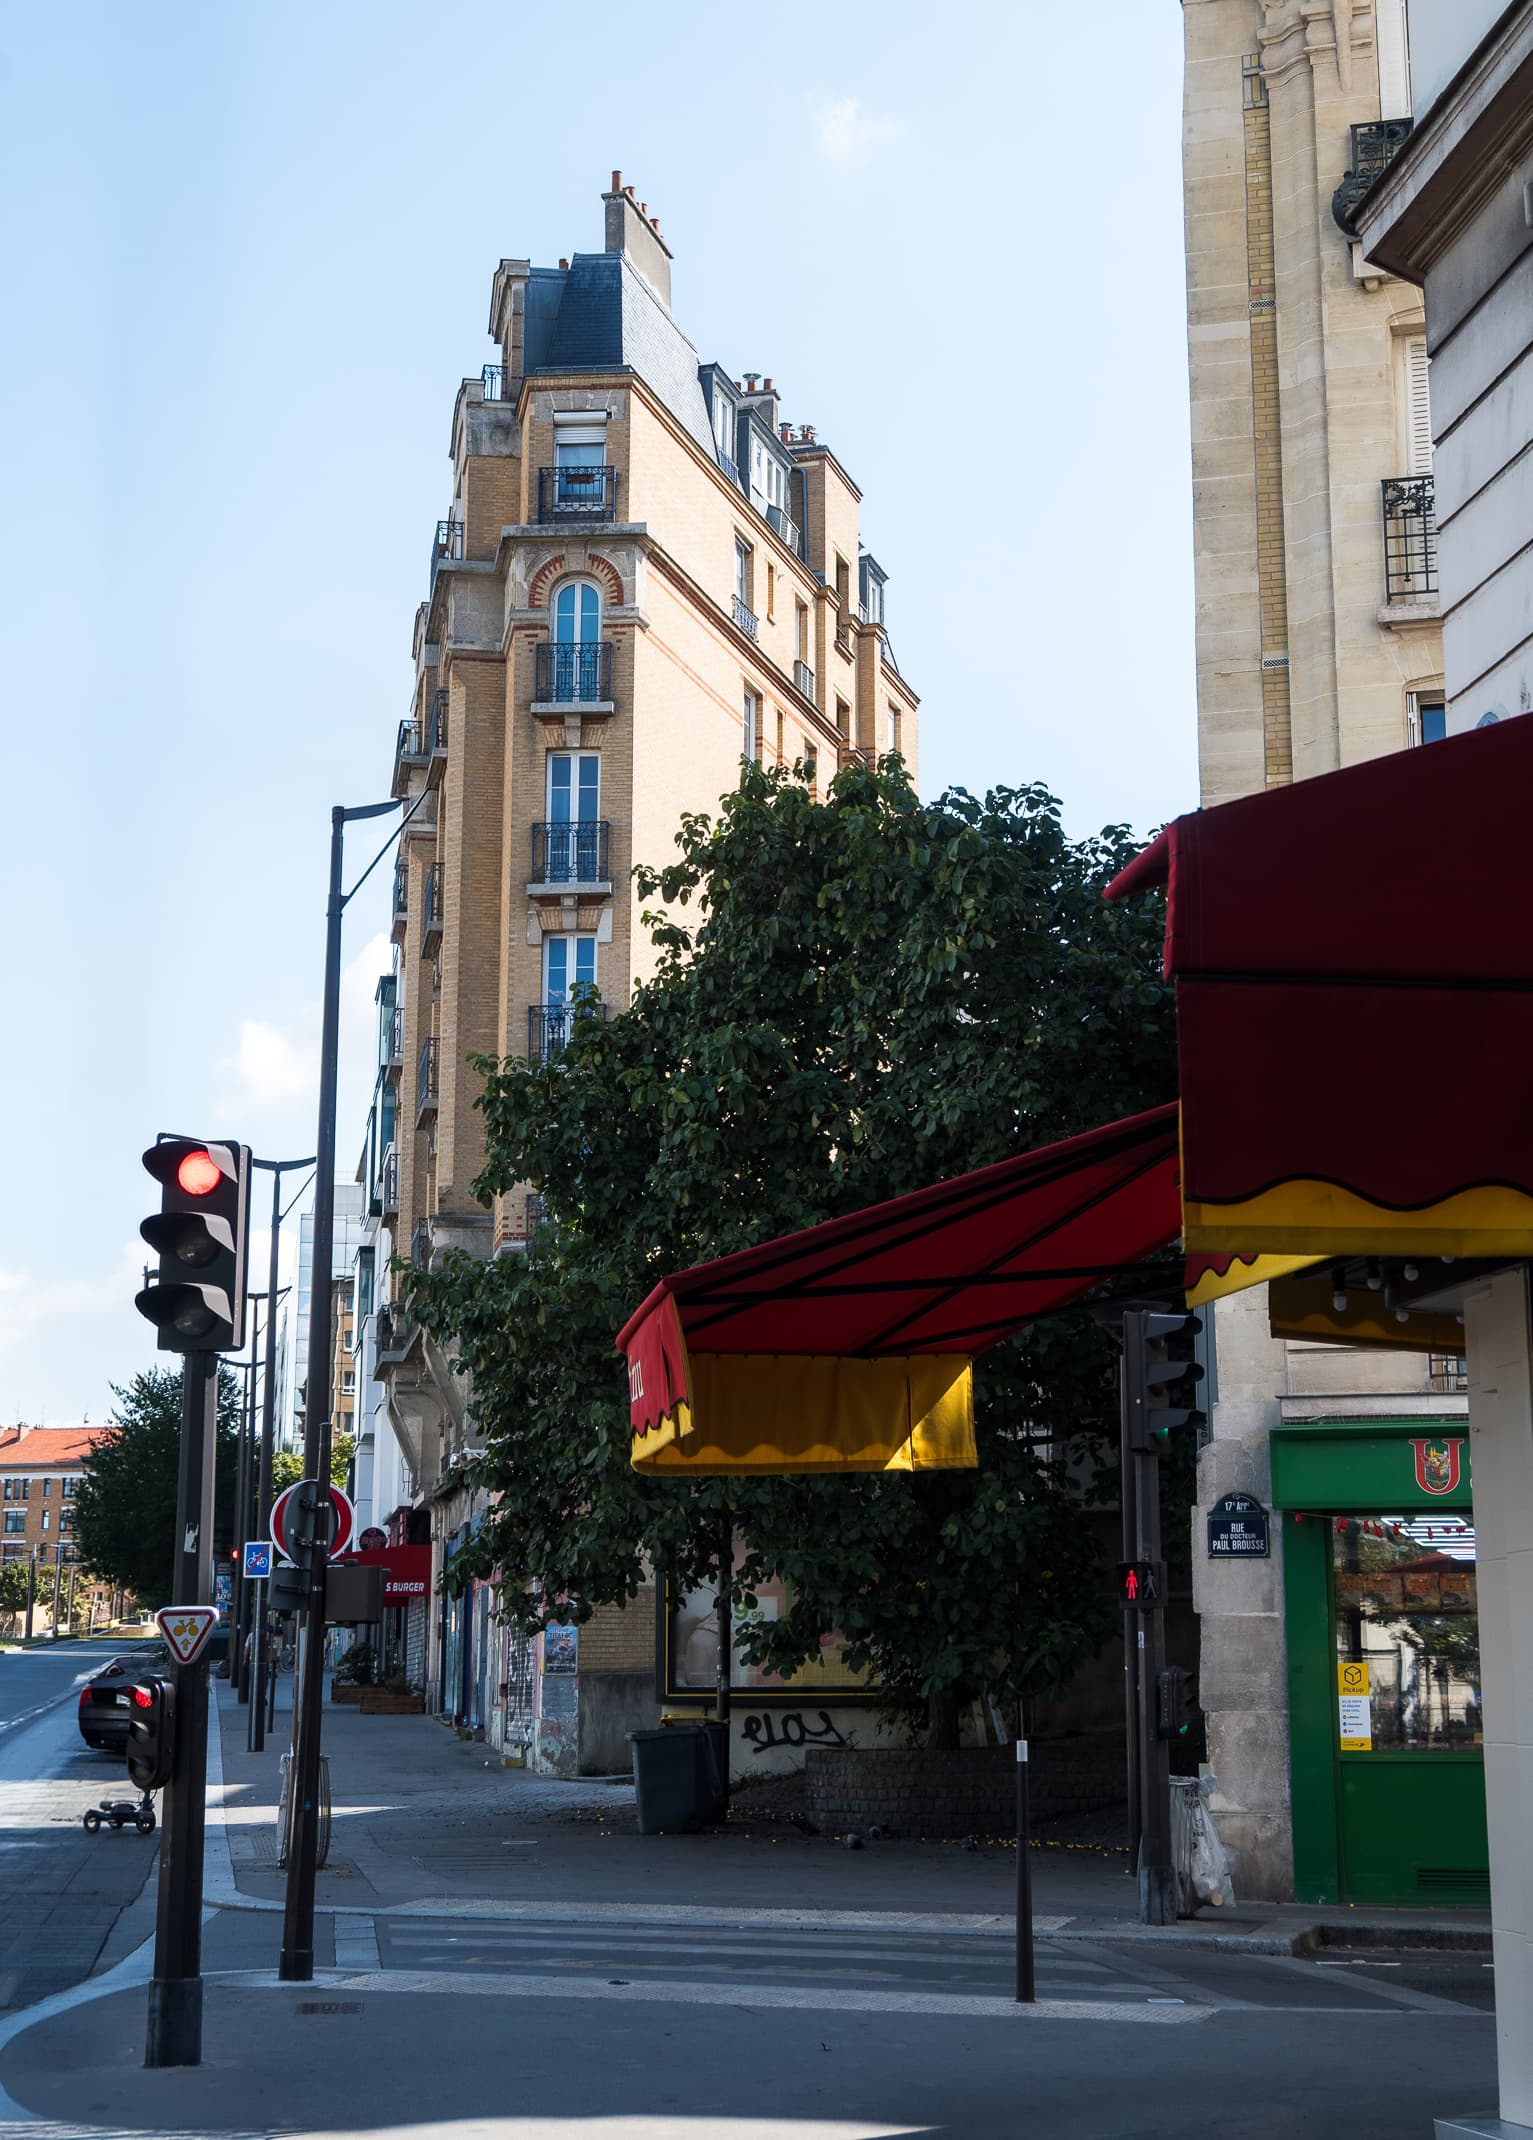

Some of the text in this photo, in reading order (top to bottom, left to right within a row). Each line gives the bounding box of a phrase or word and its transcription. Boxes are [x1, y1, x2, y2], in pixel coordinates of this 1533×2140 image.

[1408, 1438, 1465, 1495] U
[1231, 1522, 1245, 1533] RUE
[1212, 1540, 1265, 1551] PAUL BROUSSE
[392, 1582, 425, 1592] BURGER
